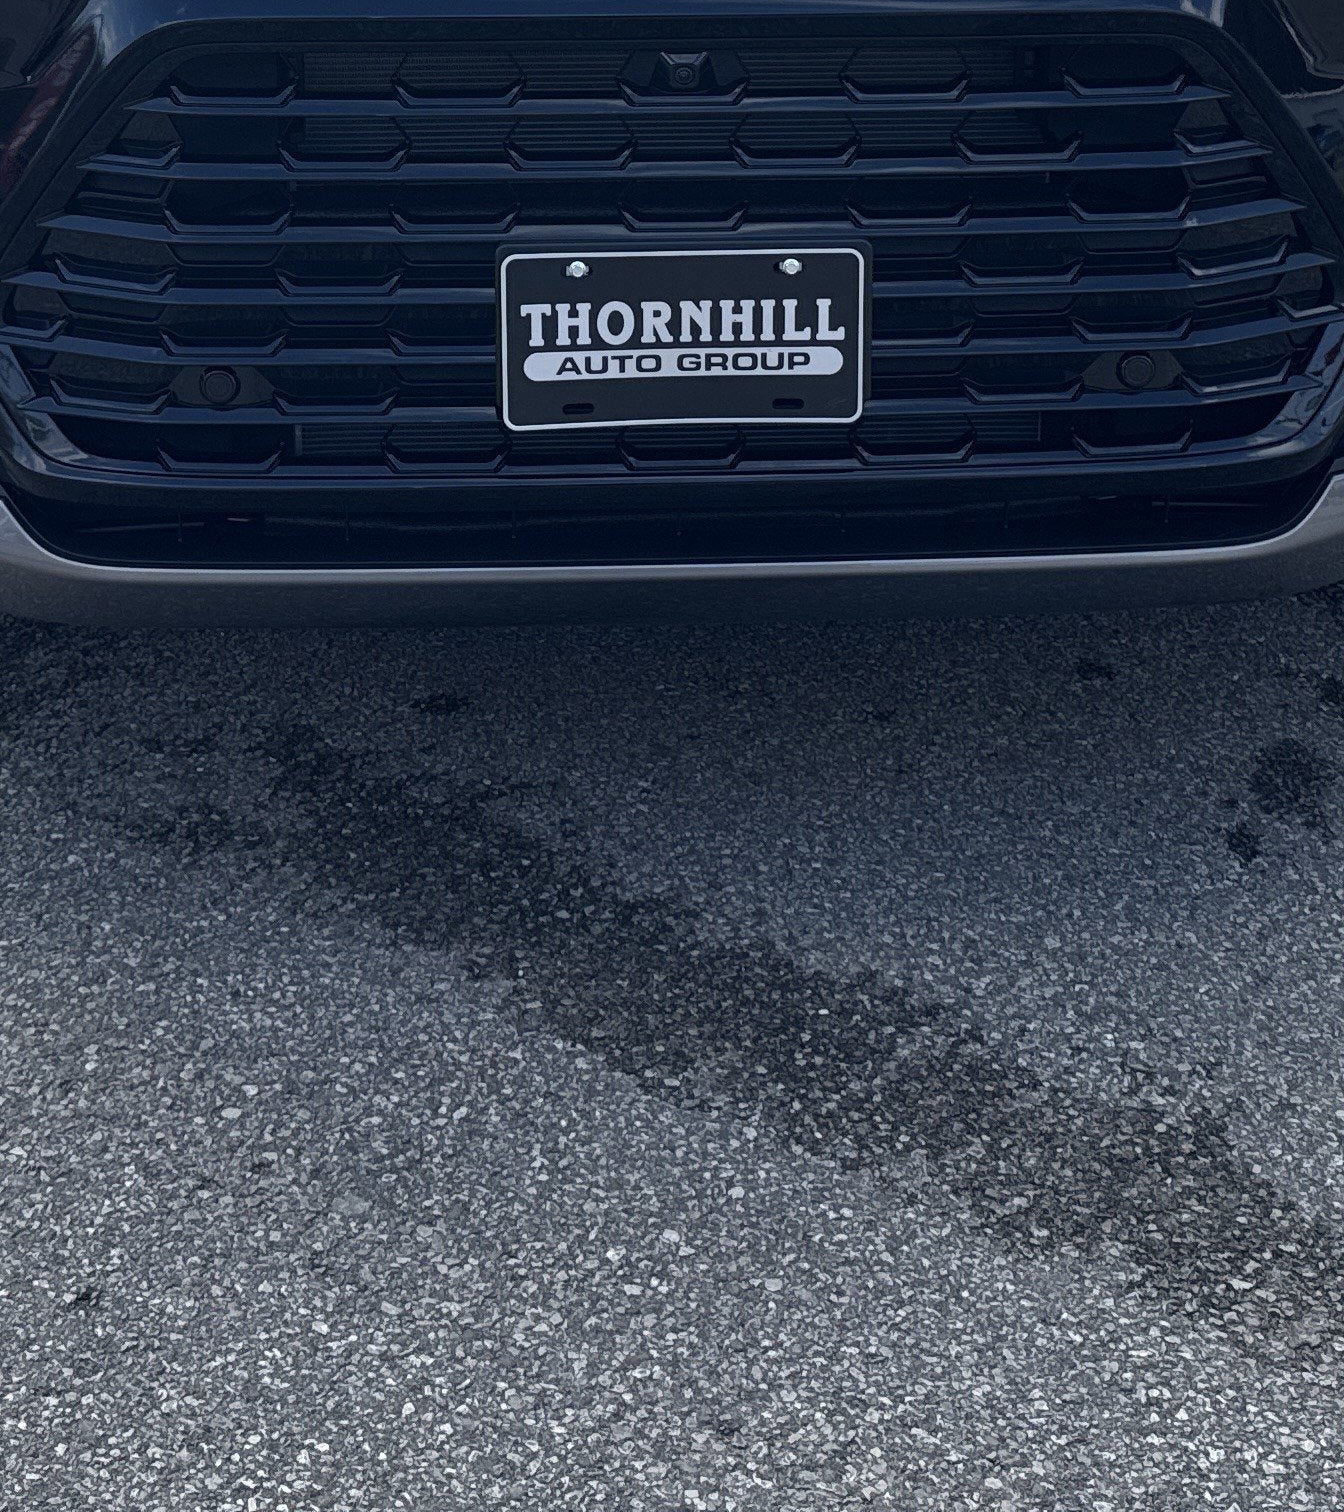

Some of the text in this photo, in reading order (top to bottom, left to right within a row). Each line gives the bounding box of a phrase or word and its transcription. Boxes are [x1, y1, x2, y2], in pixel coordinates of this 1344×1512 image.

[520, 298, 845, 347] THORNHILL
[556, 352, 811, 376] AUTO GROUP
